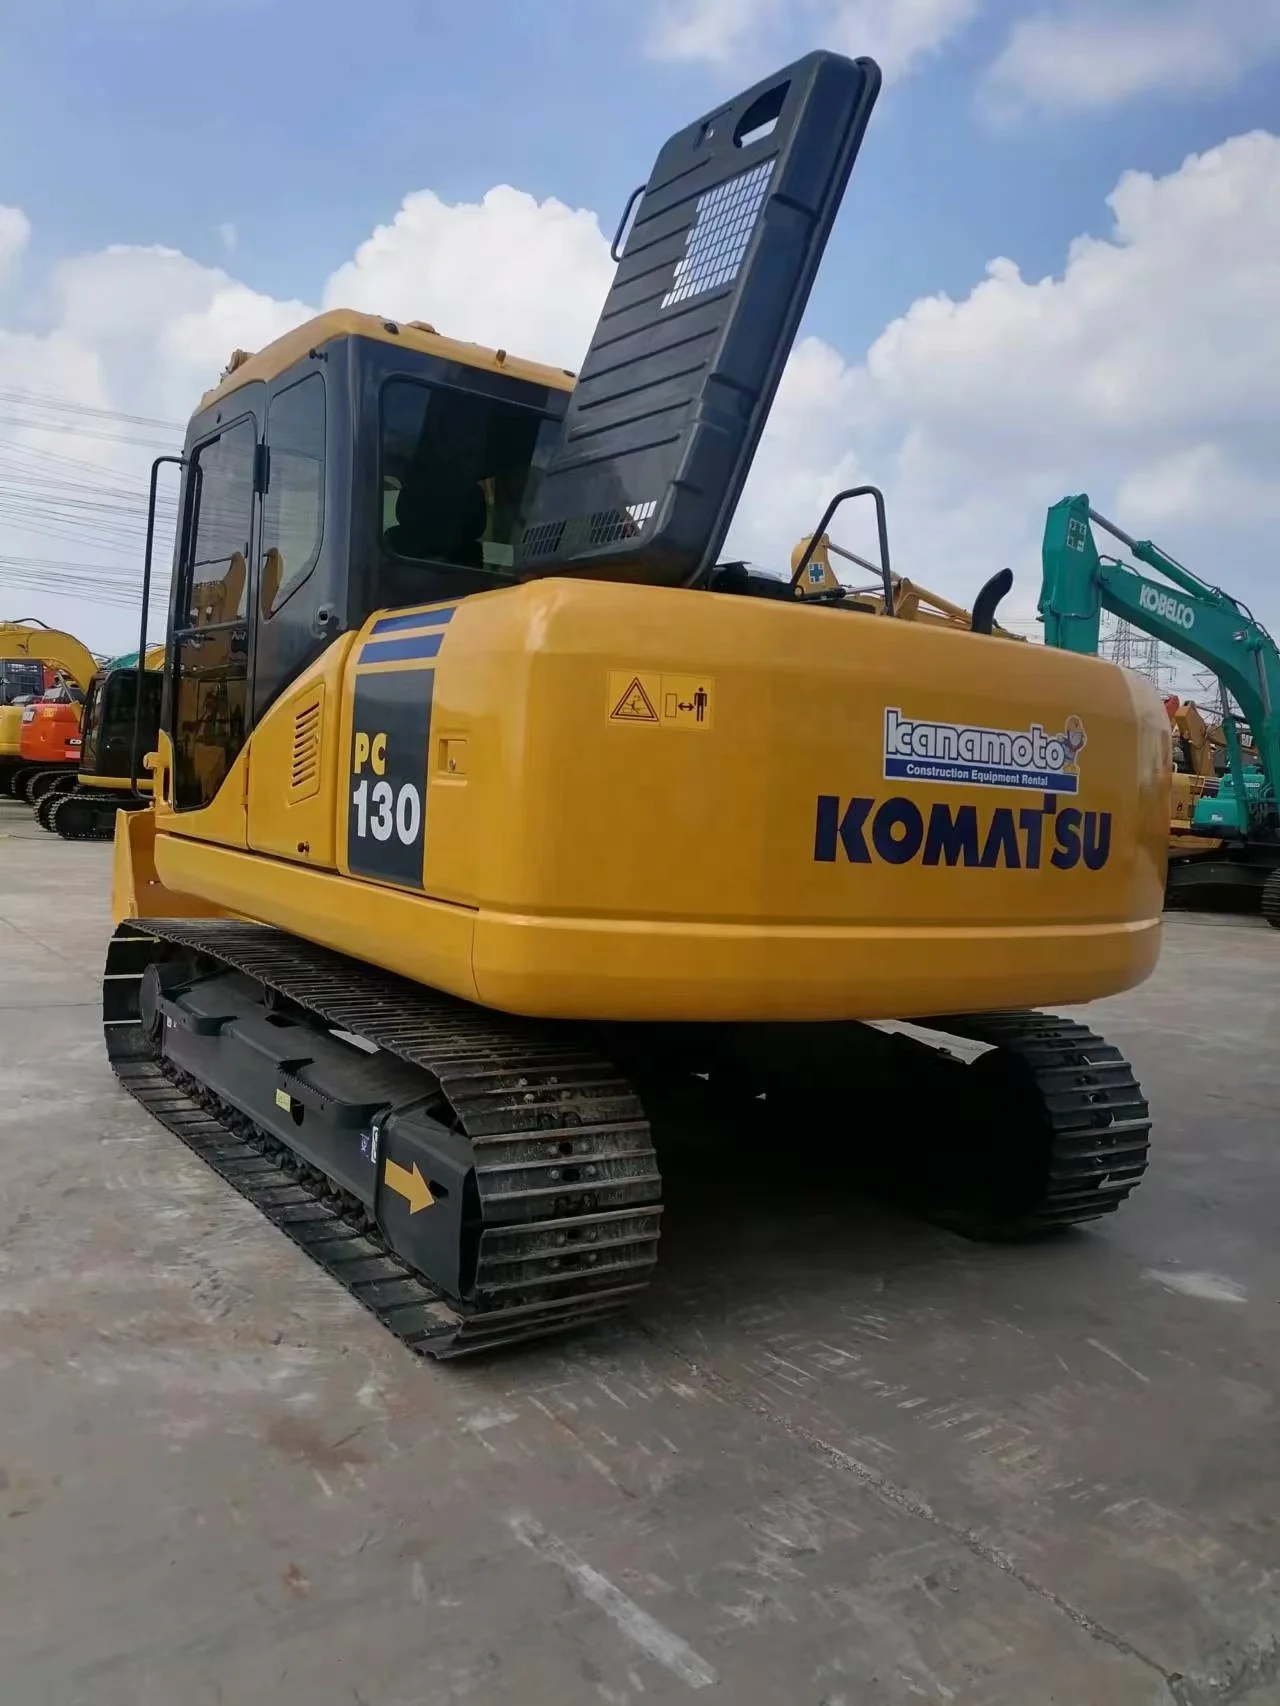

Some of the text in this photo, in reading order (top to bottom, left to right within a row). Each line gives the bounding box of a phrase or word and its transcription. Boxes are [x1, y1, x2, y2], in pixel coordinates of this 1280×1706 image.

[1138, 584, 1195, 629] KOBELCO
[354, 732, 388, 776] PC
[886, 709, 1066, 770] kanamoto
[906, 763, 1049, 786] Construction Equipment Rental
[353, 780, 421, 845] 130
[813, 794, 1112, 871] KOMATSU
